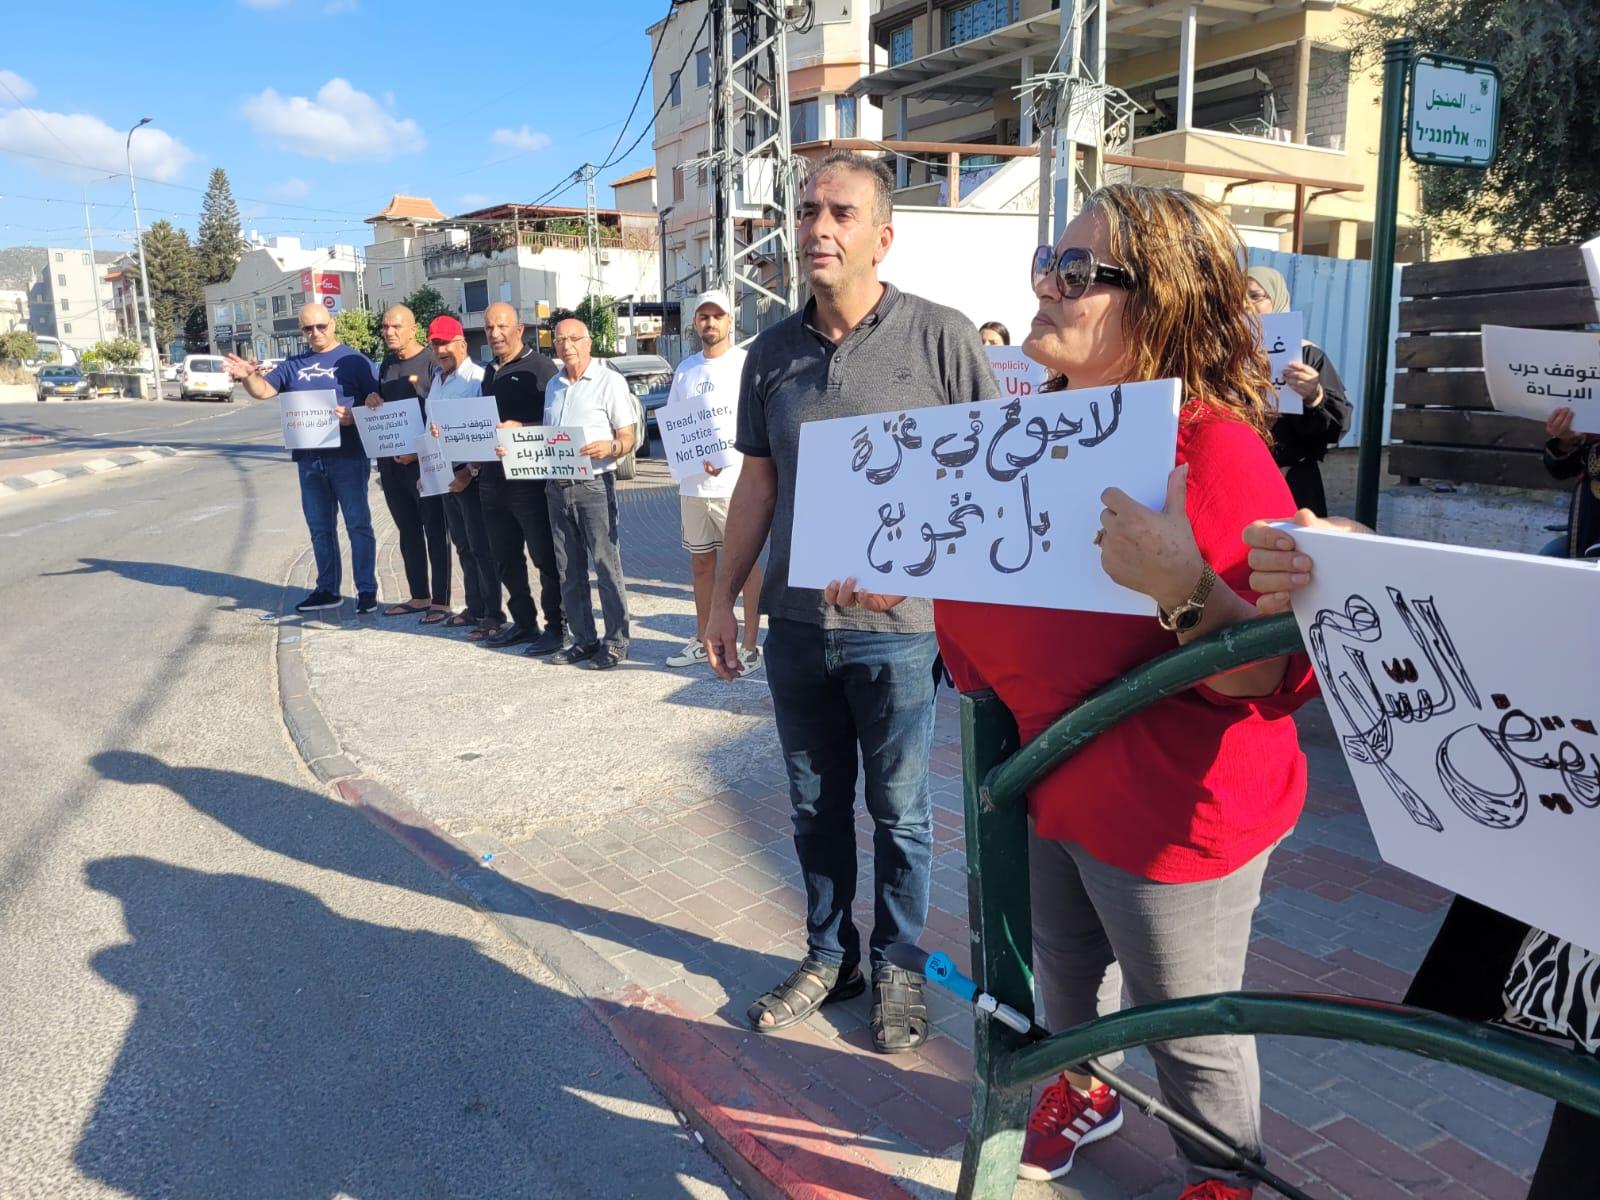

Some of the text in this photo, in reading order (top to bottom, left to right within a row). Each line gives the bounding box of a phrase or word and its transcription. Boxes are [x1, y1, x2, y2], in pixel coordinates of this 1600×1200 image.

[1426, 89, 1466, 110] المنجل
[1509, 363, 1539, 376] حرب
[1006, 377, 1031, 396] Up
[666, 412, 697, 432] Bread,
[698, 406, 732, 420] Water,
[1078, 385, 1122, 447] لا
[680, 427, 712, 444] Justice
[931, 410, 984, 480] في
[558, 448, 575, 460] لدم
[676, 439, 734, 463] Not Bombs
[510, 464, 588, 476] די להרג אזרחים
[867, 492, 984, 577] تجويع
